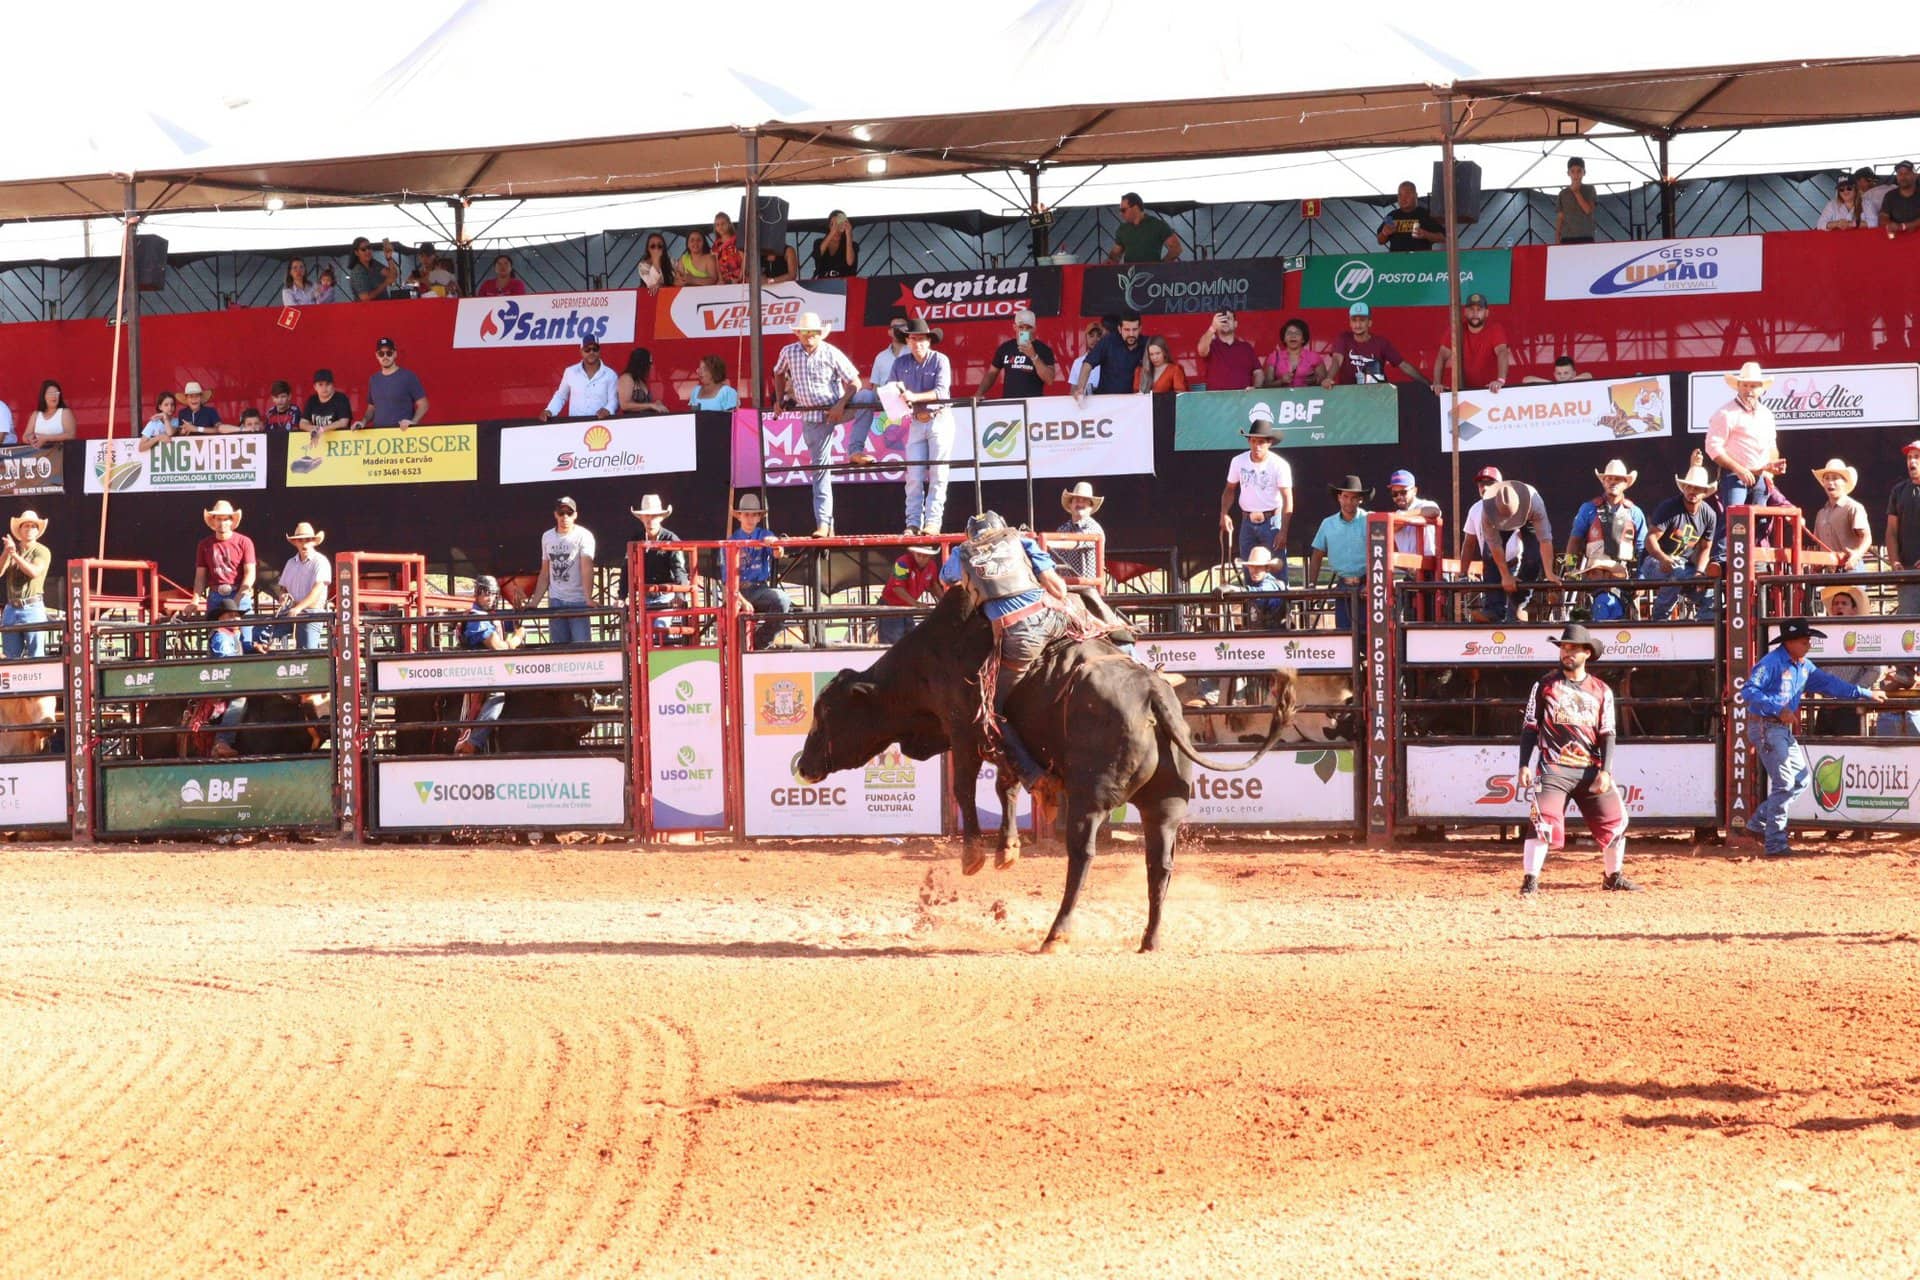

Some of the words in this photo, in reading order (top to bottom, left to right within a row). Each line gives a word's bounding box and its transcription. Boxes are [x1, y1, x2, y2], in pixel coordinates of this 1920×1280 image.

[1659, 247, 1718, 259] GESSO
[1377, 272, 1416, 284] POSTO
[1417, 272, 1434, 283] DA
[1434, 271, 1474, 284] PRÇA
[1625, 260, 1718, 282] UNIÃO
[913, 271, 1029, 302] Capital
[1663, 281, 1717, 290] DRYWALL
[551, 296, 609, 309] SUPERMERCADOS
[915, 300, 1028, 320] VEÍCULOS
[1164, 294, 1248, 313] MORIAH
[513, 310, 609, 341] Santos
[1808, 384, 1863, 409] Alice
[1278, 399, 1325, 424] B&F
[1487, 399, 1592, 423] CAMBARU
[1798, 409, 1863, 418] INCORPORADORA
[1029, 418, 1113, 442] GEDEC
[327, 435, 471, 457] REFLORESCER
[0, 456, 52, 481] NTO
[362, 456, 398, 465] Madeiras
[405, 455, 433, 464] Carvão
[152, 474, 208, 483] GEOTECNOLOGIA
[214, 472, 255, 481] TOPOGRAFIA
[1372, 545, 1384, 624] RANCHO
[1732, 541, 1744, 629] RODEIO
[73, 587, 82, 654] RANCHO
[342, 585, 351, 661] RODEIO
[1149, 650, 1197, 662] sintese
[1217, 648, 1265, 660] sintese
[1285, 647, 1336, 660] sintese
[1734, 647, 1743, 660] E
[343, 675, 351, 687] E
[1374, 638, 1385, 741] PORTEIRA
[74, 667, 83, 756] PORTEIRA
[658, 703, 712, 716] USONET
[343, 703, 353, 817] COMPANHIA
[660, 768, 714, 781] USONET
[864, 770, 915, 783] FCN
[1374, 755, 1385, 807] VEIA
[1845, 764, 1908, 796] Shōjiki
[76, 768, 86, 813] VEIA
[208, 777, 249, 803] B&F
[770, 787, 847, 806] GEDEC
[865, 792, 916, 803] FUNDAÇÃO
[867, 804, 914, 812] CULTURAL
